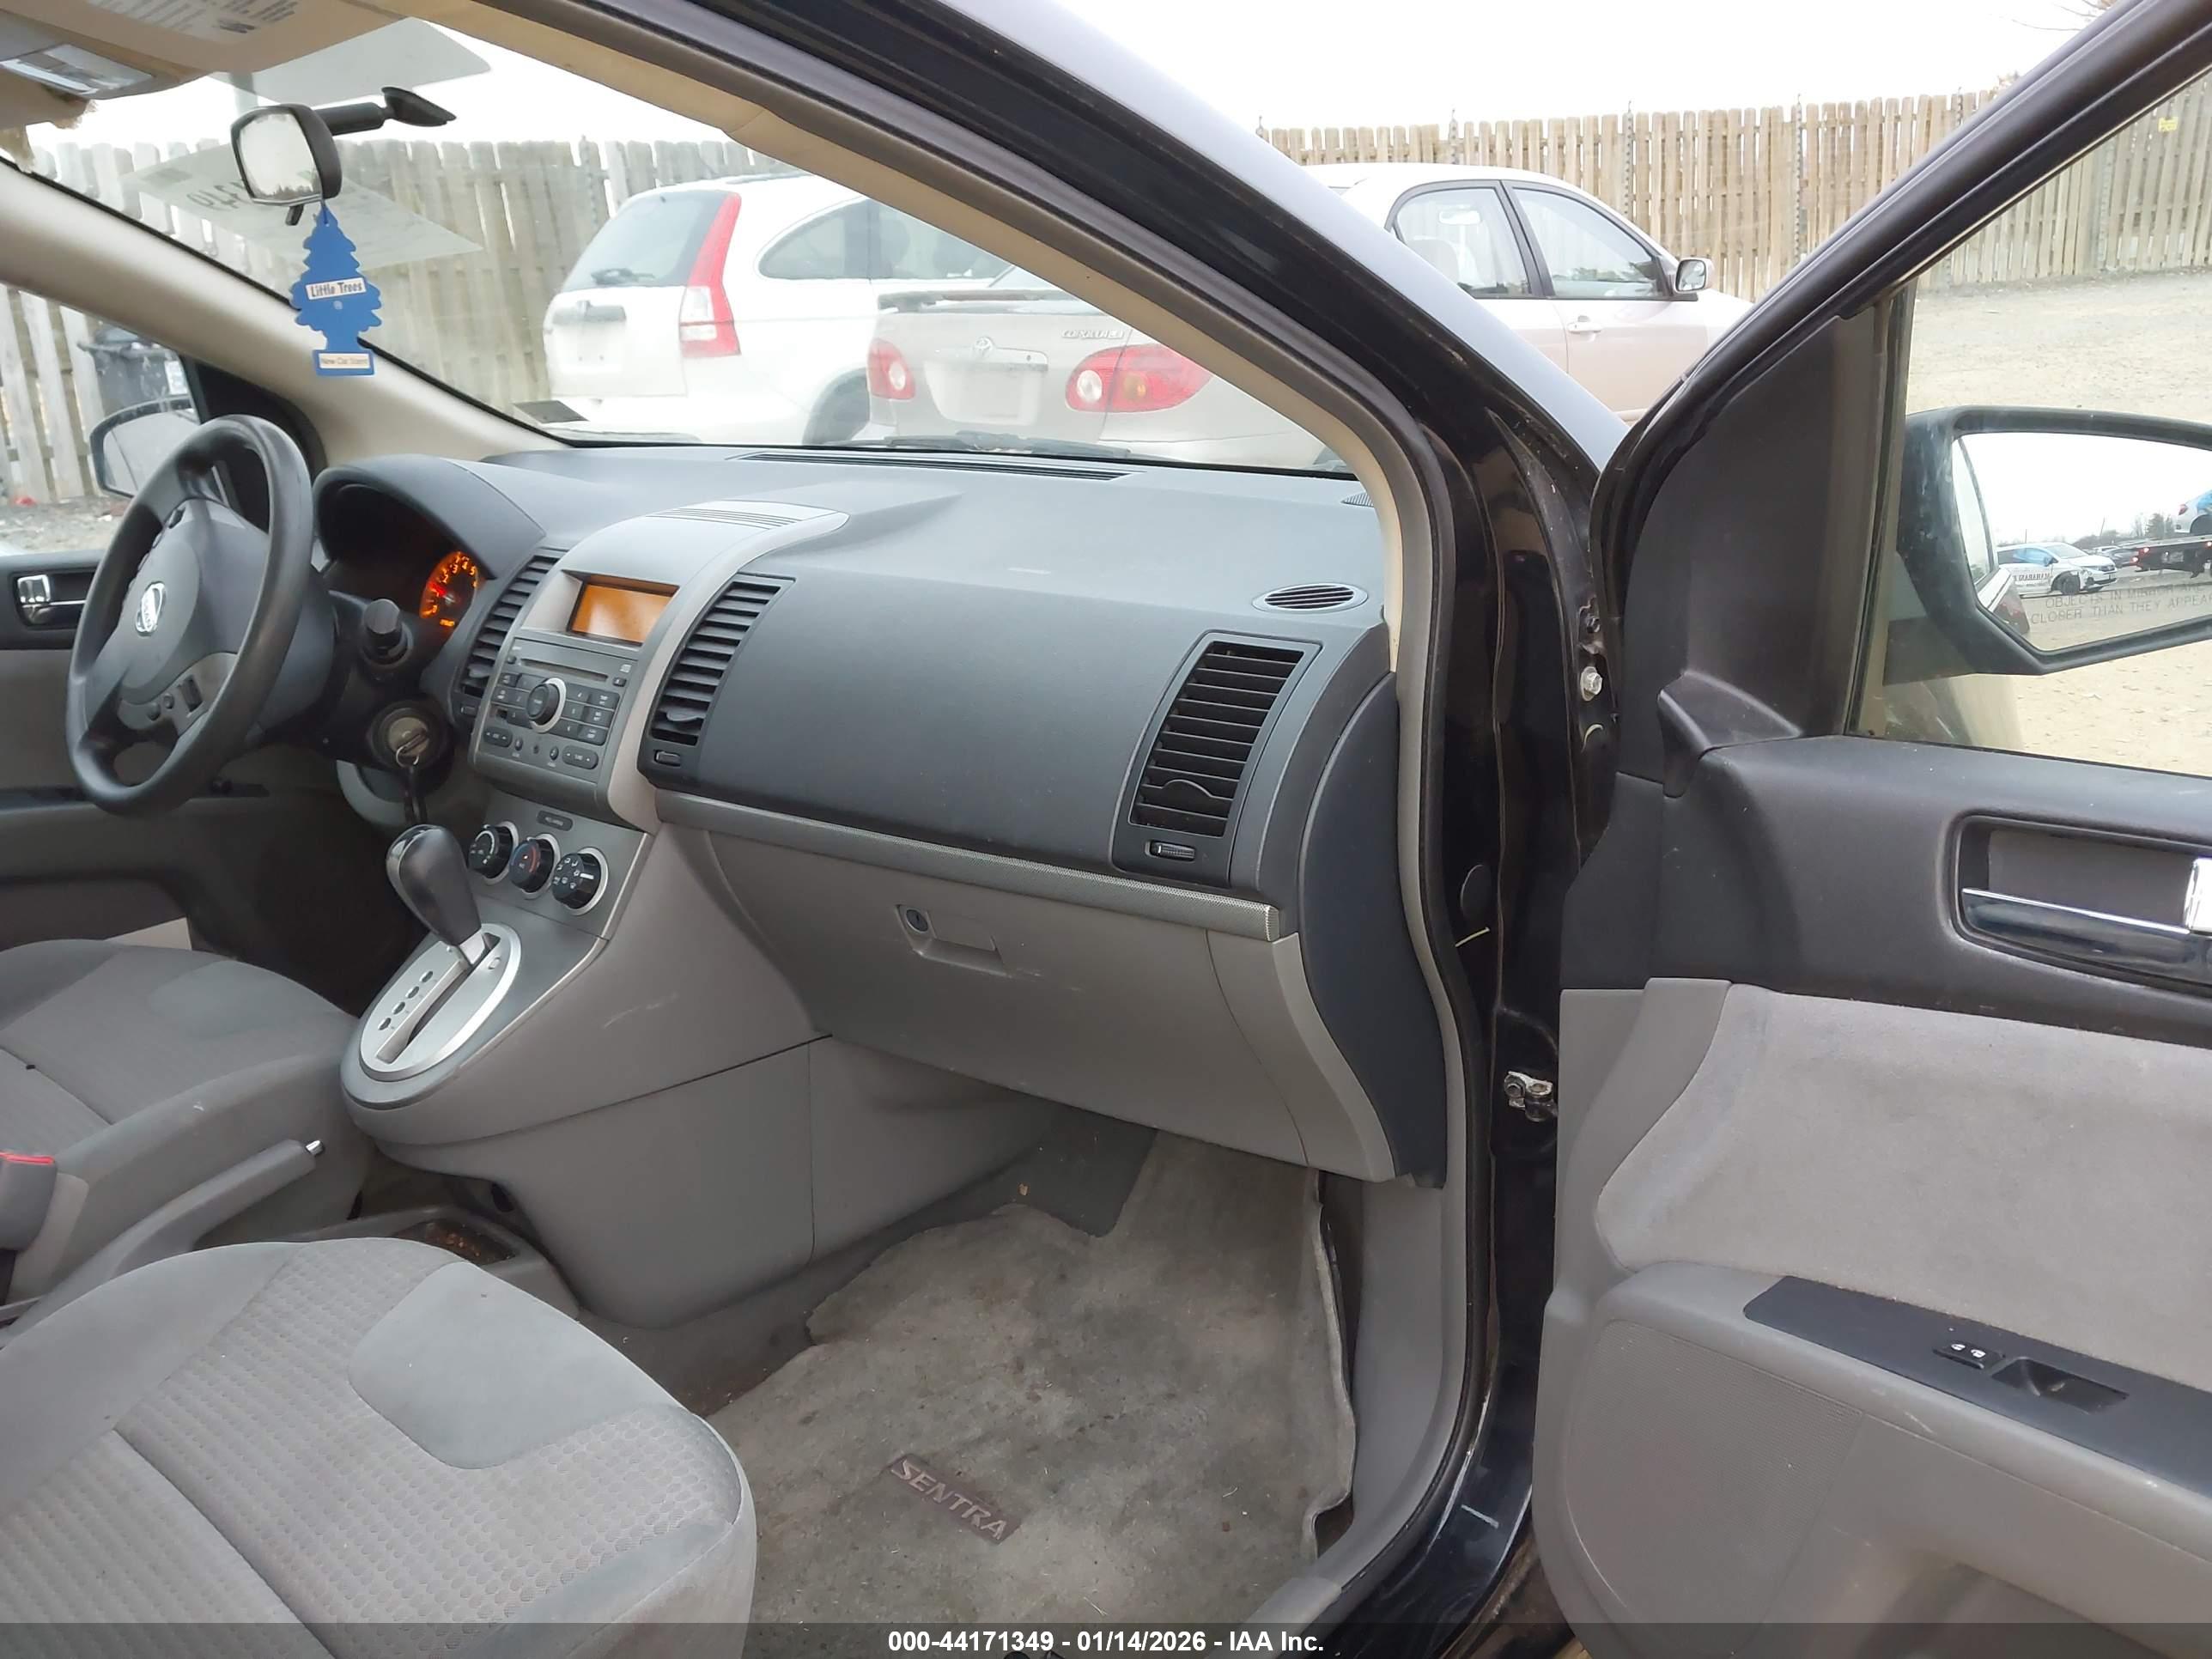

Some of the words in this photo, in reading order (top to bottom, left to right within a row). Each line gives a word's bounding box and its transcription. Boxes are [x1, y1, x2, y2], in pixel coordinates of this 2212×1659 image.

[310, 283, 335, 298] Little
[337, 281, 362, 294] Trees
[2046, 593, 2103, 608] OBJECTS
[2110, 589, 2123, 601] IN
[2128, 585, 2174, 599] MIRROR
[2032, 608, 2082, 624] CLOSER
[2092, 604, 2124, 617] THAN
[2130, 600, 2160, 612] THEY
[890, 1459, 1007, 1540] SENTRA
